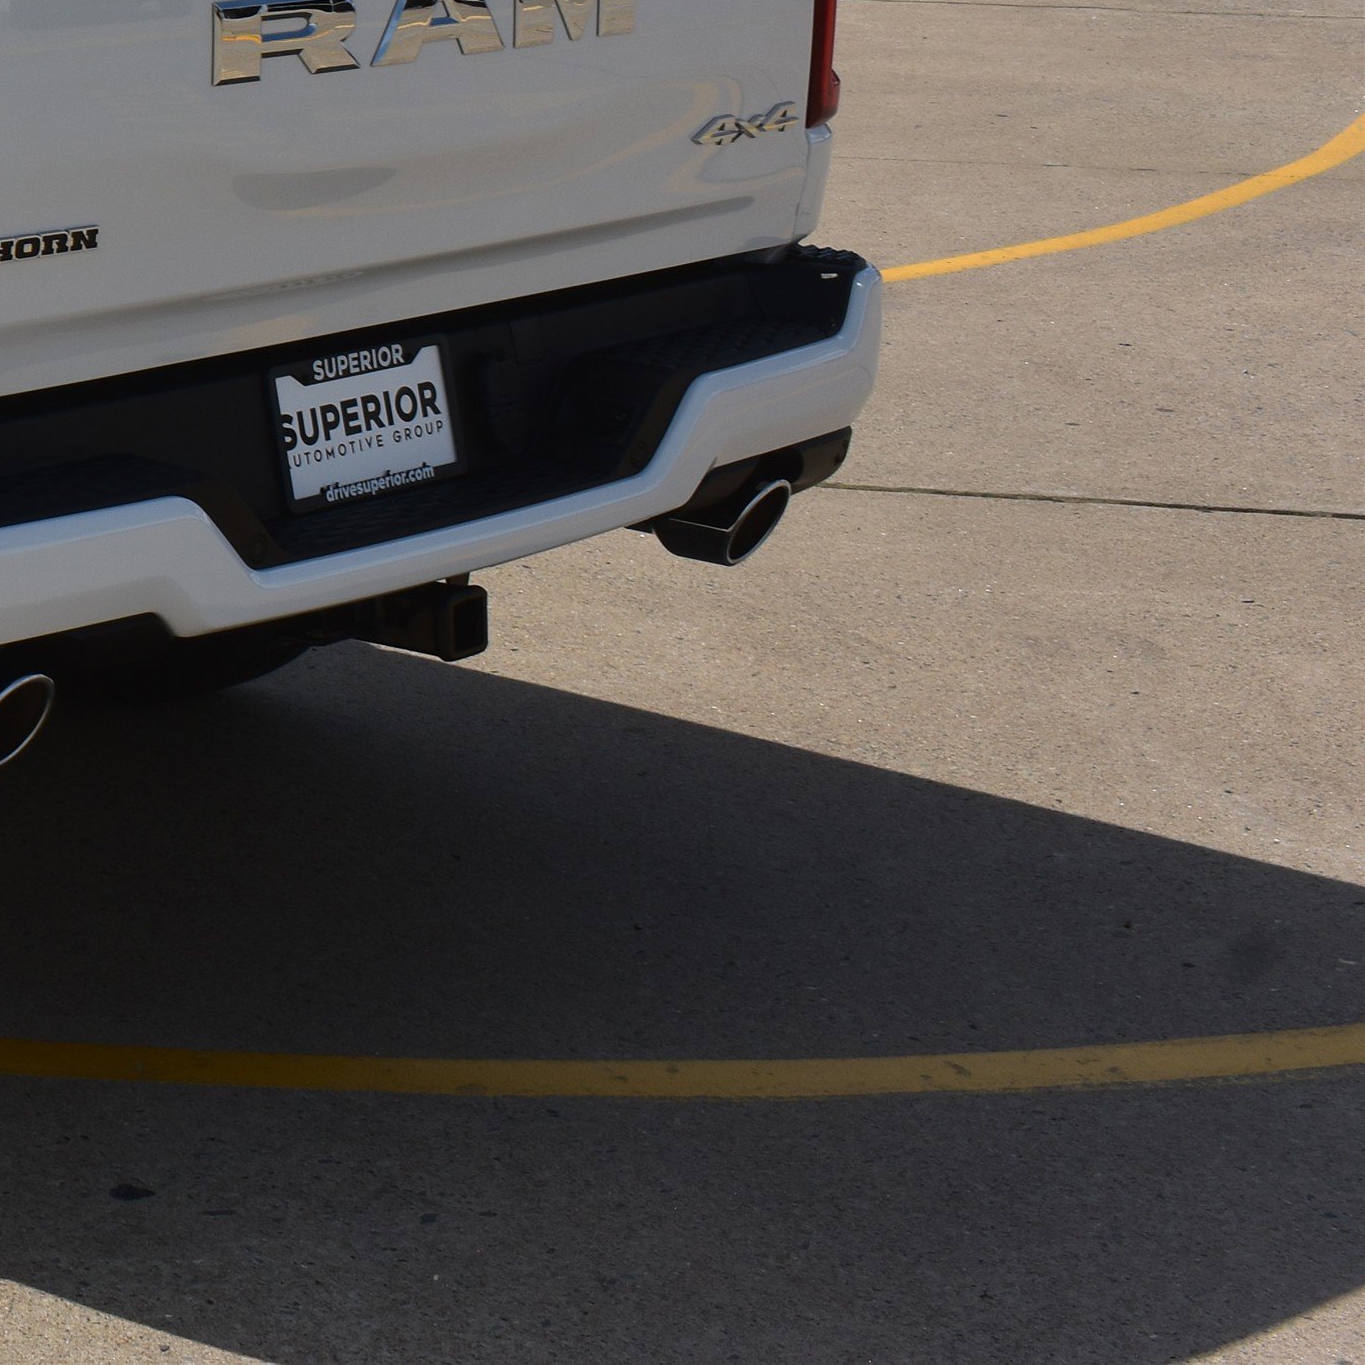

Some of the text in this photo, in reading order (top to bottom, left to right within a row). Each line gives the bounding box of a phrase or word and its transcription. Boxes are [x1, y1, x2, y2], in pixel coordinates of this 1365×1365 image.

[312, 343, 405, 381] SUPERIOR
[280, 381, 442, 451] SUPERIOR
[292, 420, 444, 468] UTOMOTIVE GROUP
[325, 464, 435, 502] drivesuperior.com
